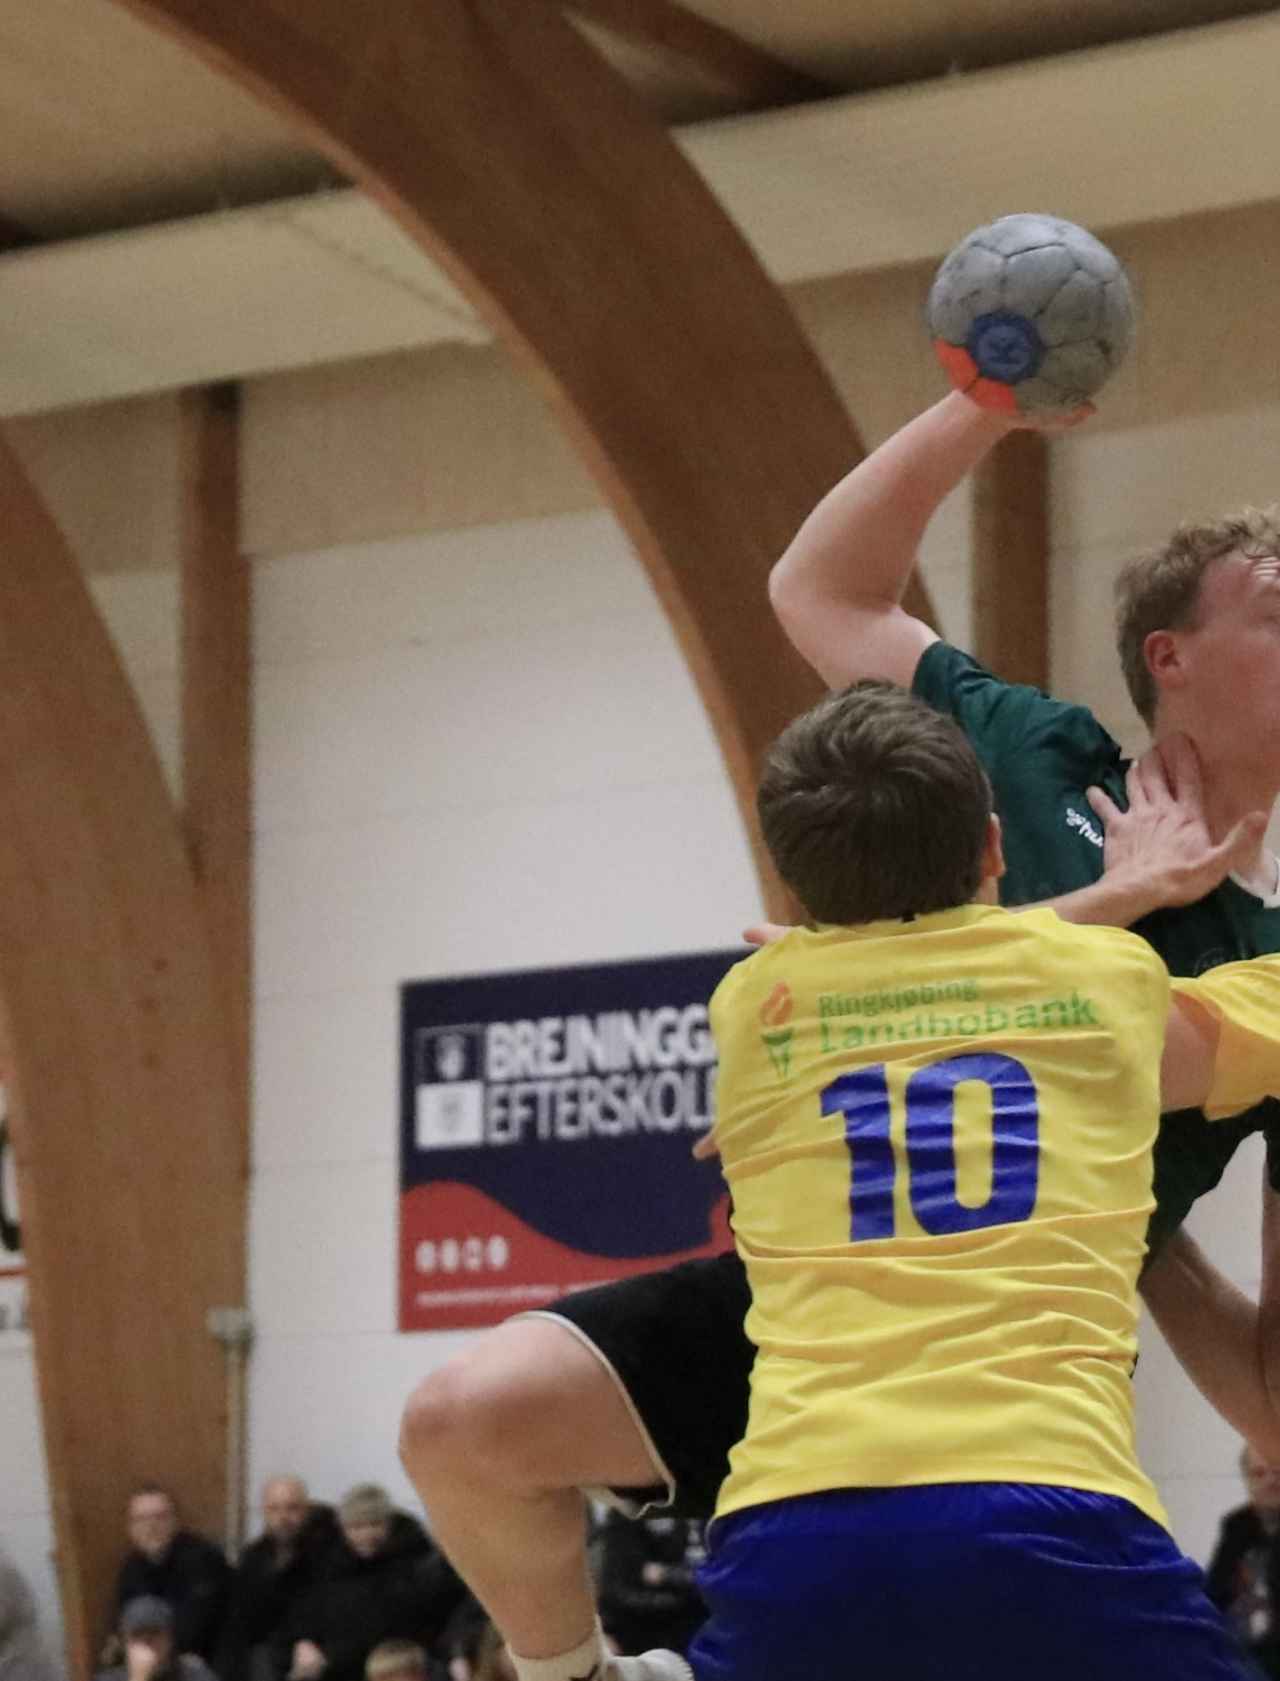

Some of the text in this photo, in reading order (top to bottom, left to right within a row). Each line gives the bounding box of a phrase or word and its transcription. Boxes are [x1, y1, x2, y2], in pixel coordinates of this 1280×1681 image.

[486, 1003, 717, 1083] BREJNINGG
[819, 990, 1097, 1053] Landbobank
[820, 1052, 1038, 1242] 10
